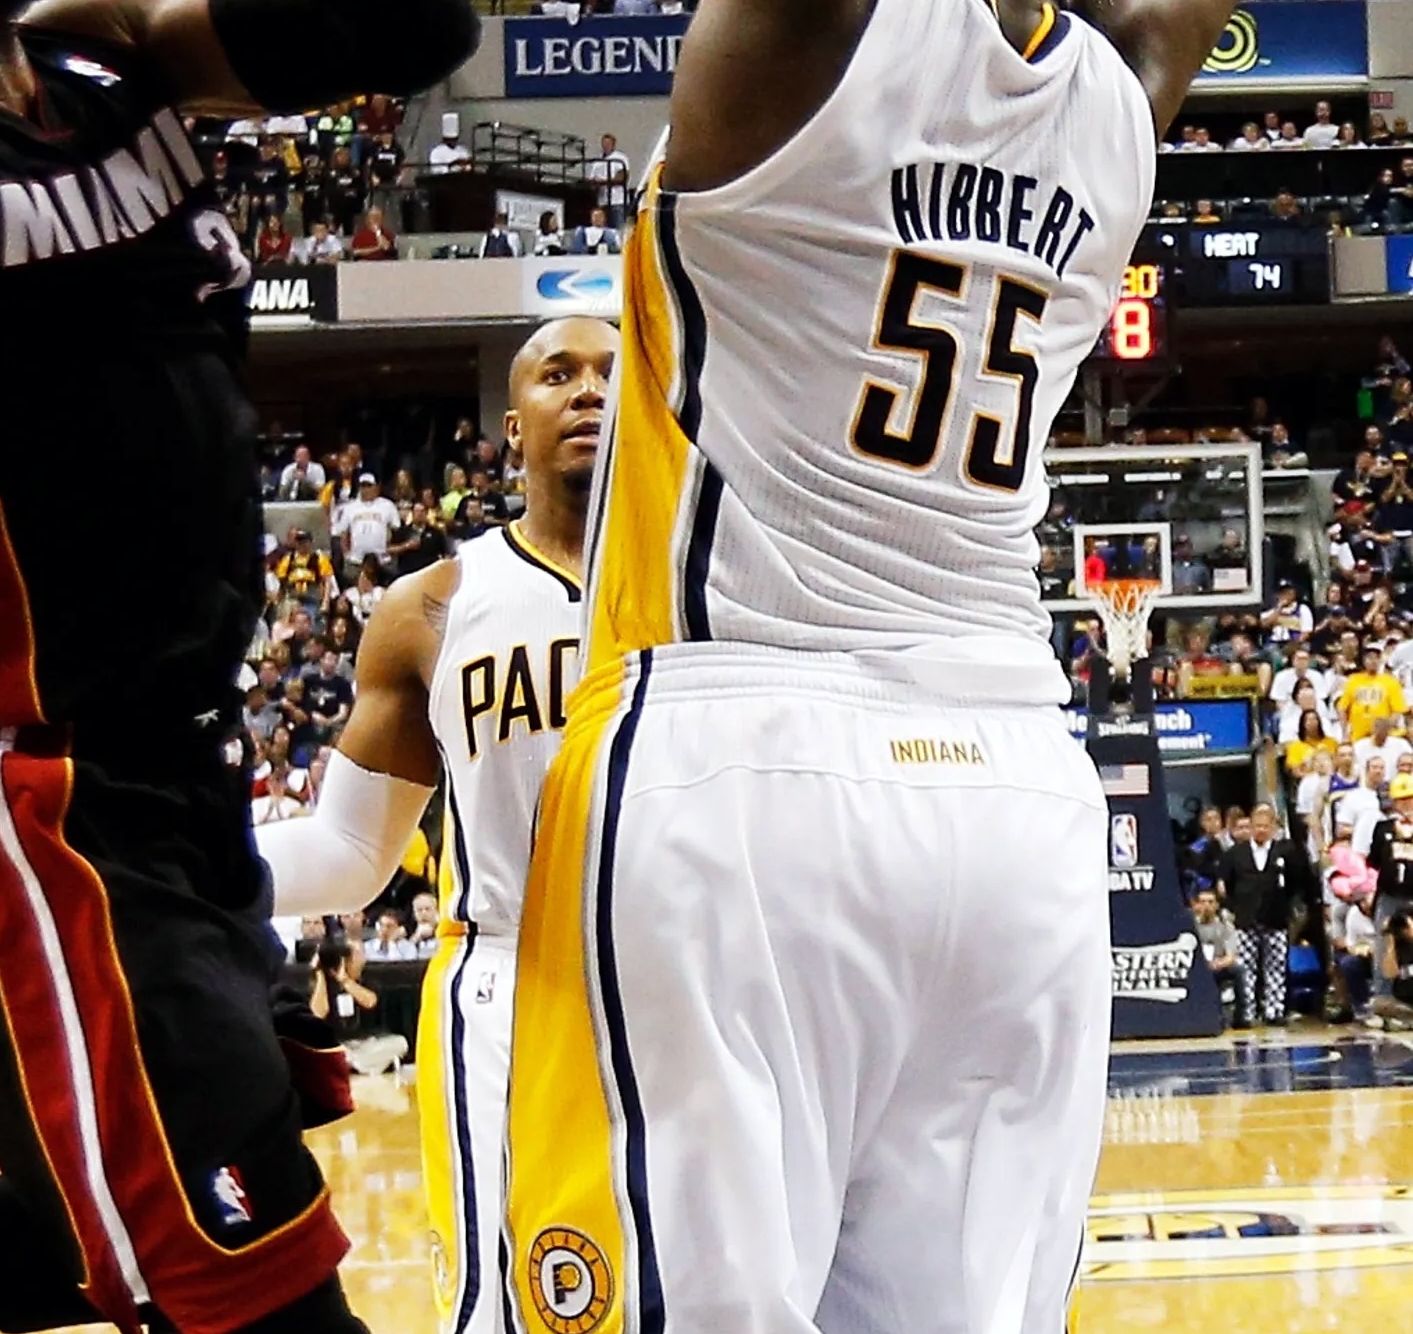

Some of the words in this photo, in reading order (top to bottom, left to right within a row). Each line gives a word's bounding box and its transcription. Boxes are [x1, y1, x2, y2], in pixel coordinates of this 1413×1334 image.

[891, 161, 1095, 281] HIBBERT
[1204, 232, 1260, 257] HEAT
[1249, 263, 1281, 289] 74
[1112, 299, 1151, 359] 8
[848, 246, 1051, 493] 55
[890, 739, 985, 764] INDIANA
[1132, 871, 1154, 890] TV
[1112, 951, 1194, 969] STERN
[1113, 979, 1170, 990] INALS
